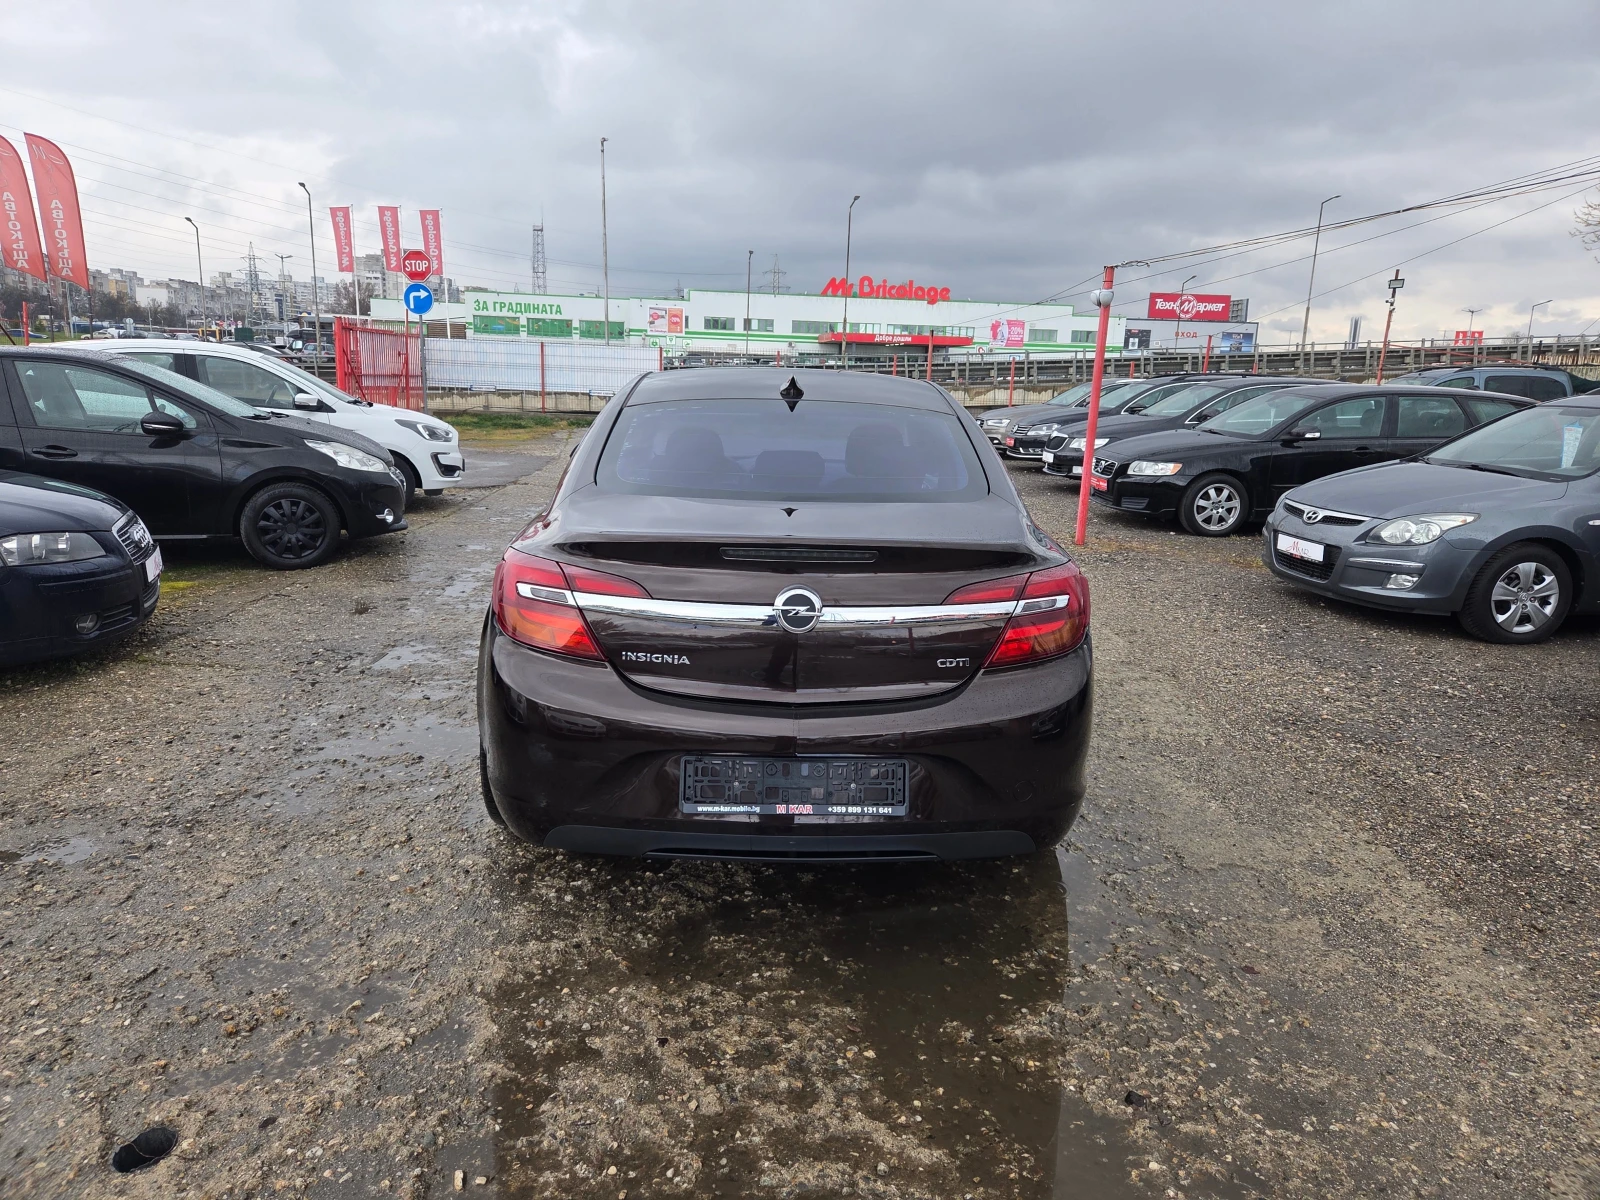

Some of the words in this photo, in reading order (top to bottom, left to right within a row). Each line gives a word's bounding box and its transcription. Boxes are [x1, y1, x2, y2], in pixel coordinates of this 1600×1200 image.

[404, 260, 429, 272] STOP
[858, 275, 951, 306] Bricolage
[474, 300, 489, 312] ЗА
[493, 301, 563, 316] ГРАДИНАТА
[1008, 326, 1024, 335] -20%
[1174, 331, 1198, 339] ВХОД
[874, 334, 893, 343] Добре
[621, 651, 691, 665] INSIGNIA
[697, 805, 760, 813] www.m-kar.mobile.bg
[776, 804, 787, 814] M
[789, 804, 813, 815] KAR
[847, 806, 862, 814] 899
